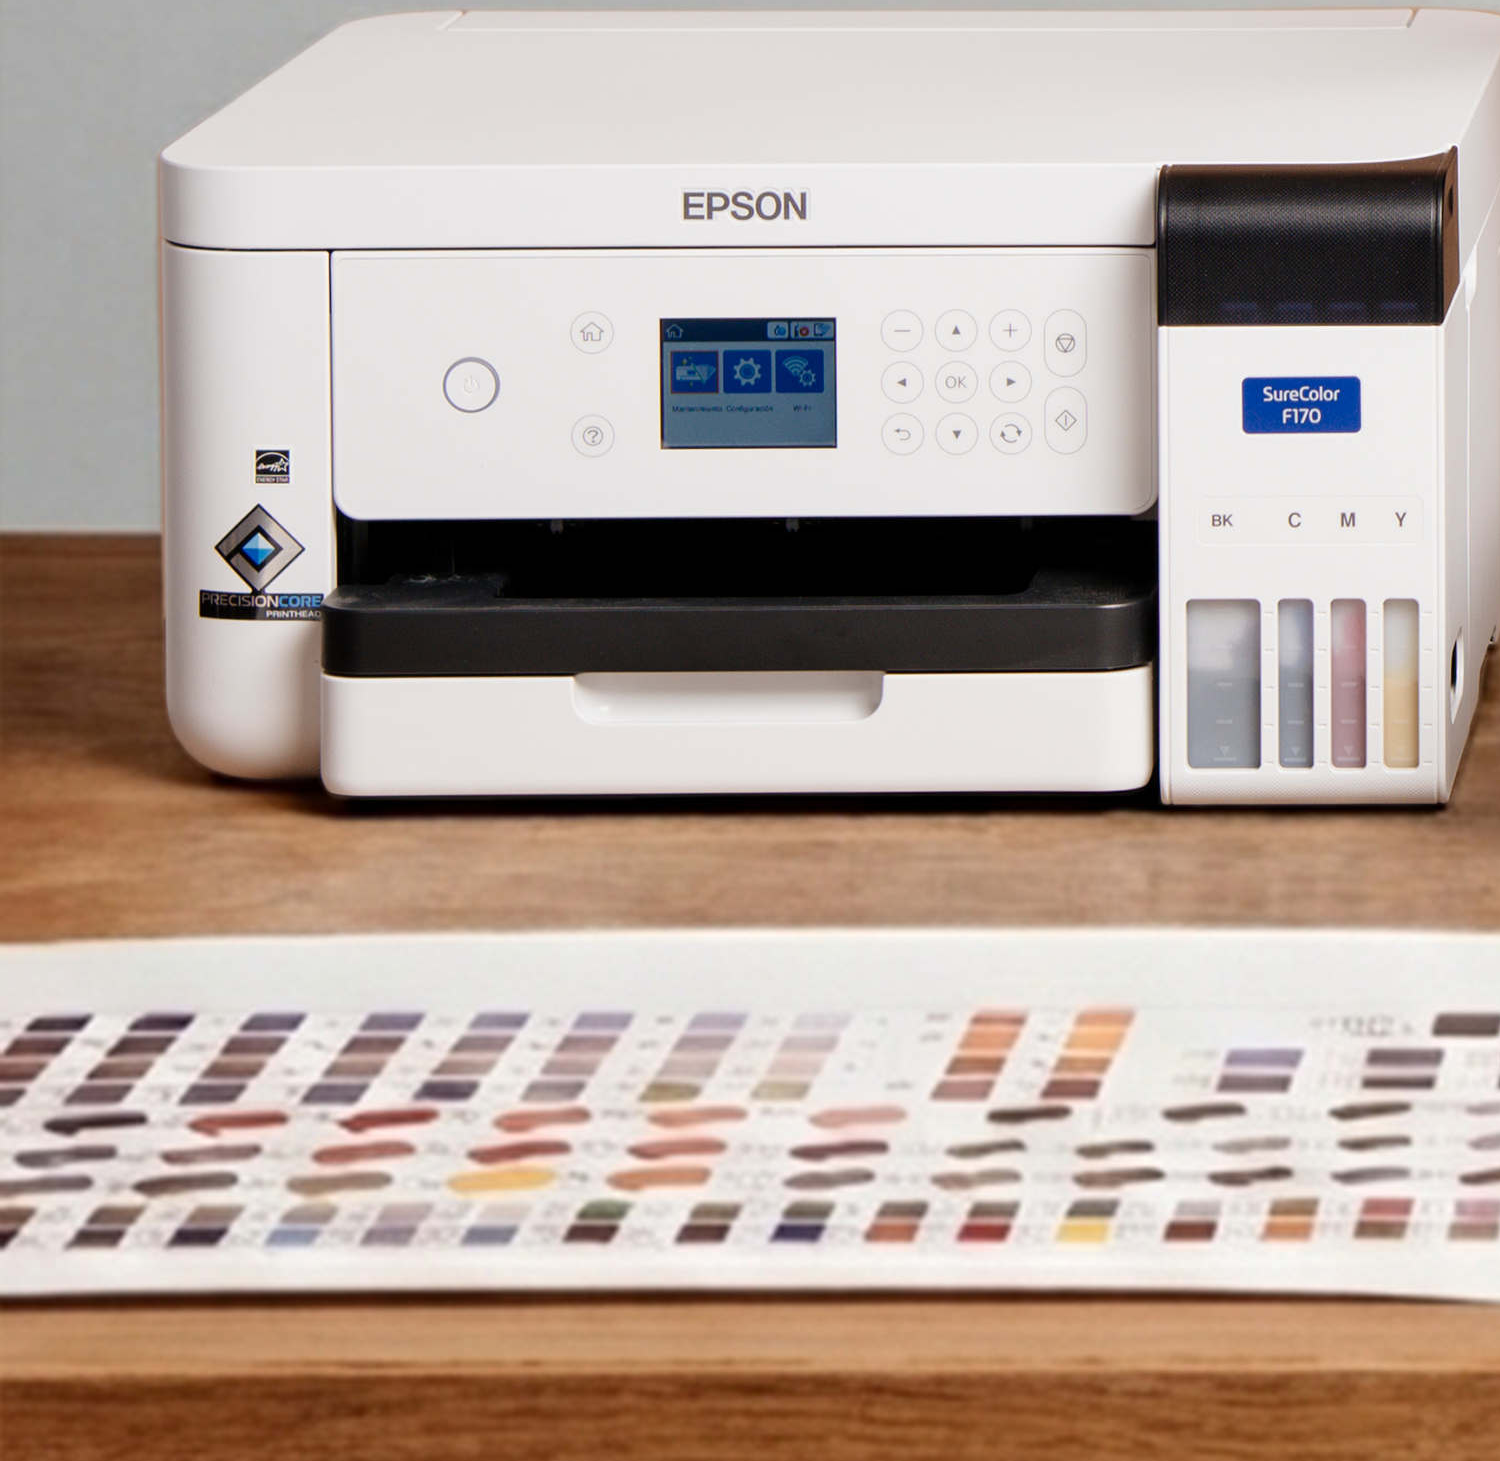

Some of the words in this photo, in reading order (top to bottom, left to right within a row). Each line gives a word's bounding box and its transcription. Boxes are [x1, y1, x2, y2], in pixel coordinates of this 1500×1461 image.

[683, 191, 807, 220] EPSON
[945, 375, 967, 389] OK
[1262, 385, 1341, 402] SureColor
[725, 405, 774, 414] Configuración
[792, 405, 812, 413] Wi-Fi
[1282, 407, 1322, 424] F170
[1211, 513, 1233, 527] BK
[1287, 512, 1302, 528] C
[1340, 512, 1356, 527] M
[1394, 512, 1407, 527] Y
[201, 592, 322, 608] PRECISIONCORE
[265, 610, 322, 618] PRINTHEAD
